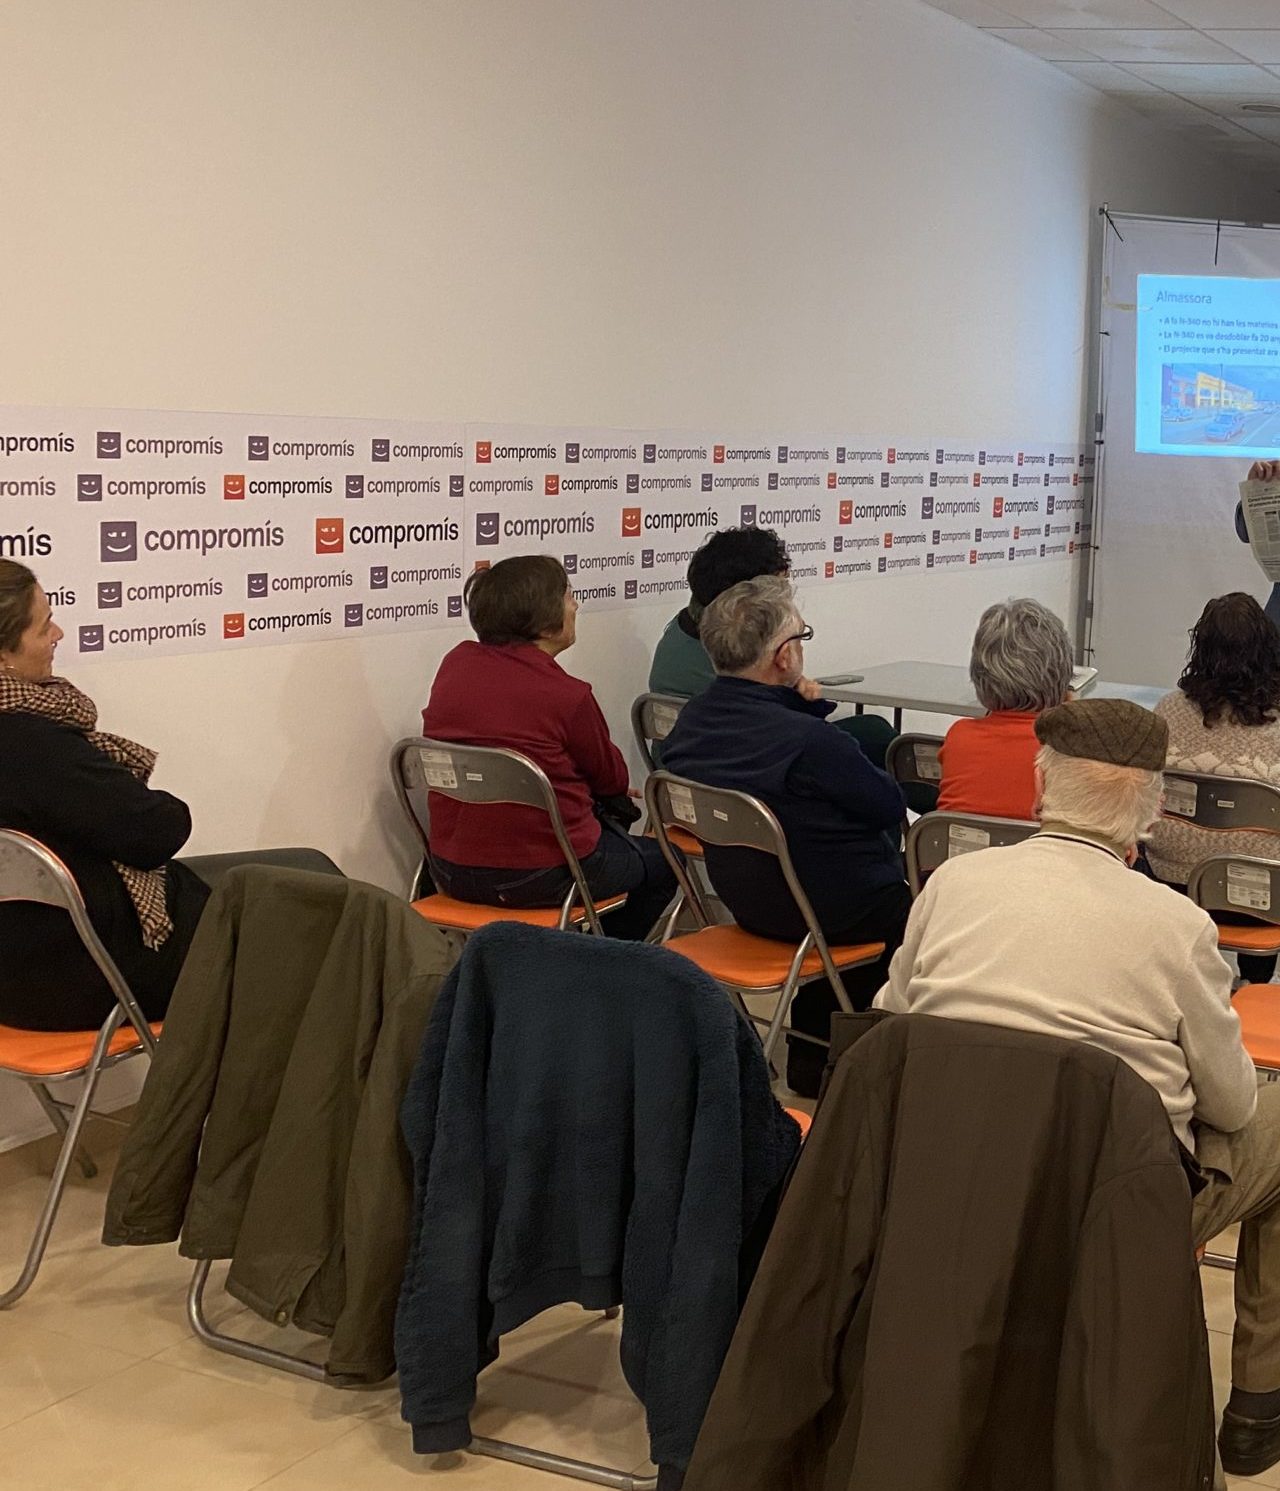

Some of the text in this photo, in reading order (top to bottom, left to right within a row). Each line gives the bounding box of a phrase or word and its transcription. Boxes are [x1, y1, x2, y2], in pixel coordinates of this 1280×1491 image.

[1156, 290, 1212, 304] Almassora
[1215, 332, 1250, 341] desdoblar
[1260, 334, 1269, 342] 20
[1172, 345, 1200, 354] projecte
[1202, 347, 1215, 355] que
[126, 436, 223, 458] compromís
[273, 440, 355, 459] compromís
[393, 442, 463, 461] compromís
[494, 443, 557, 462] compromís
[582, 444, 637, 463] compromís
[658, 446, 707, 463] compromís
[727, 446, 771, 463] compromís
[789, 447, 829, 463] compromís
[107, 477, 206, 499] compromís
[249, 476, 333, 498] compromís
[367, 476, 441, 497] compromís
[469, 476, 533, 495] compromís
[561, 475, 618, 494] compromís
[641, 474, 691, 491] compromís
[714, 473, 759, 490] compromís
[779, 473, 820, 488] compromís
[759, 504, 821, 528] compromís
[854, 500, 906, 522] compromís
[935, 497, 980, 519] compromís
[504, 511, 595, 540] compromís
[644, 507, 718, 533] compromís
[144, 520, 284, 556] compromís
[349, 517, 459, 549] compromís
[787, 538, 826, 554] compromís
[579, 552, 635, 570] compromís
[272, 570, 353, 594] compromís
[391, 563, 461, 585] compromís
[127, 578, 223, 603] compromís
[639, 577, 689, 596] compromís
[366, 599, 438, 621] compromís
[248, 608, 332, 632] compromís
[108, 619, 207, 645] compromís
